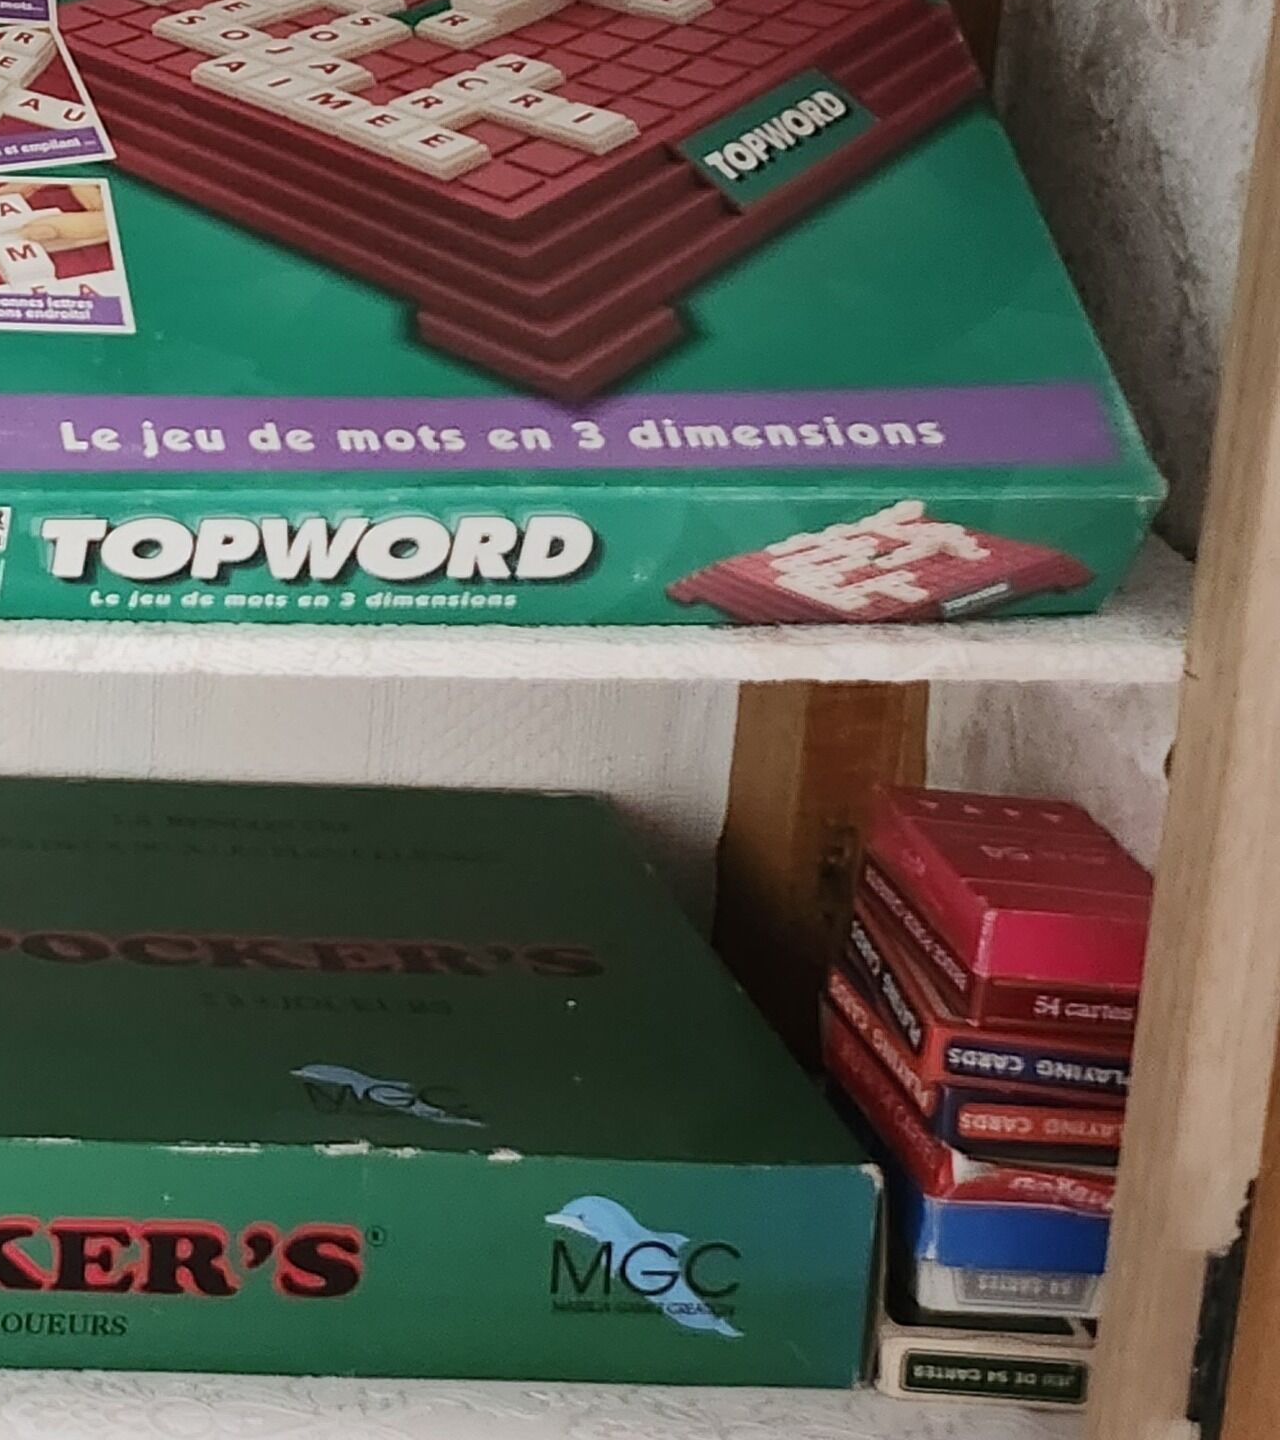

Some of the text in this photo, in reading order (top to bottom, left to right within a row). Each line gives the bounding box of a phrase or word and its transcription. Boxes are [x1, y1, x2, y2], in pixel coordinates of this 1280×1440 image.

[4, 143, 20, 157] et
[21, 137, 81, 157] empilant
[702, 87, 848, 184] TOPWORD
[47, 295, 94, 310] lettres
[59, 415, 946, 459] Le jeu de mots en 3 dimensions
[40, 514, 598, 582] TOPWORD
[89, 589, 518, 609] Le jeu de mots en 3 dimensions
[1033, 995, 1135, 1021] 54 cartes
[947, 1046, 1025, 1075] CARDS
[957, 1109, 1032, 1134] CARDS
[550, 1239, 742, 1299] MGC
[913, 1364, 982, 1383] CARTES
